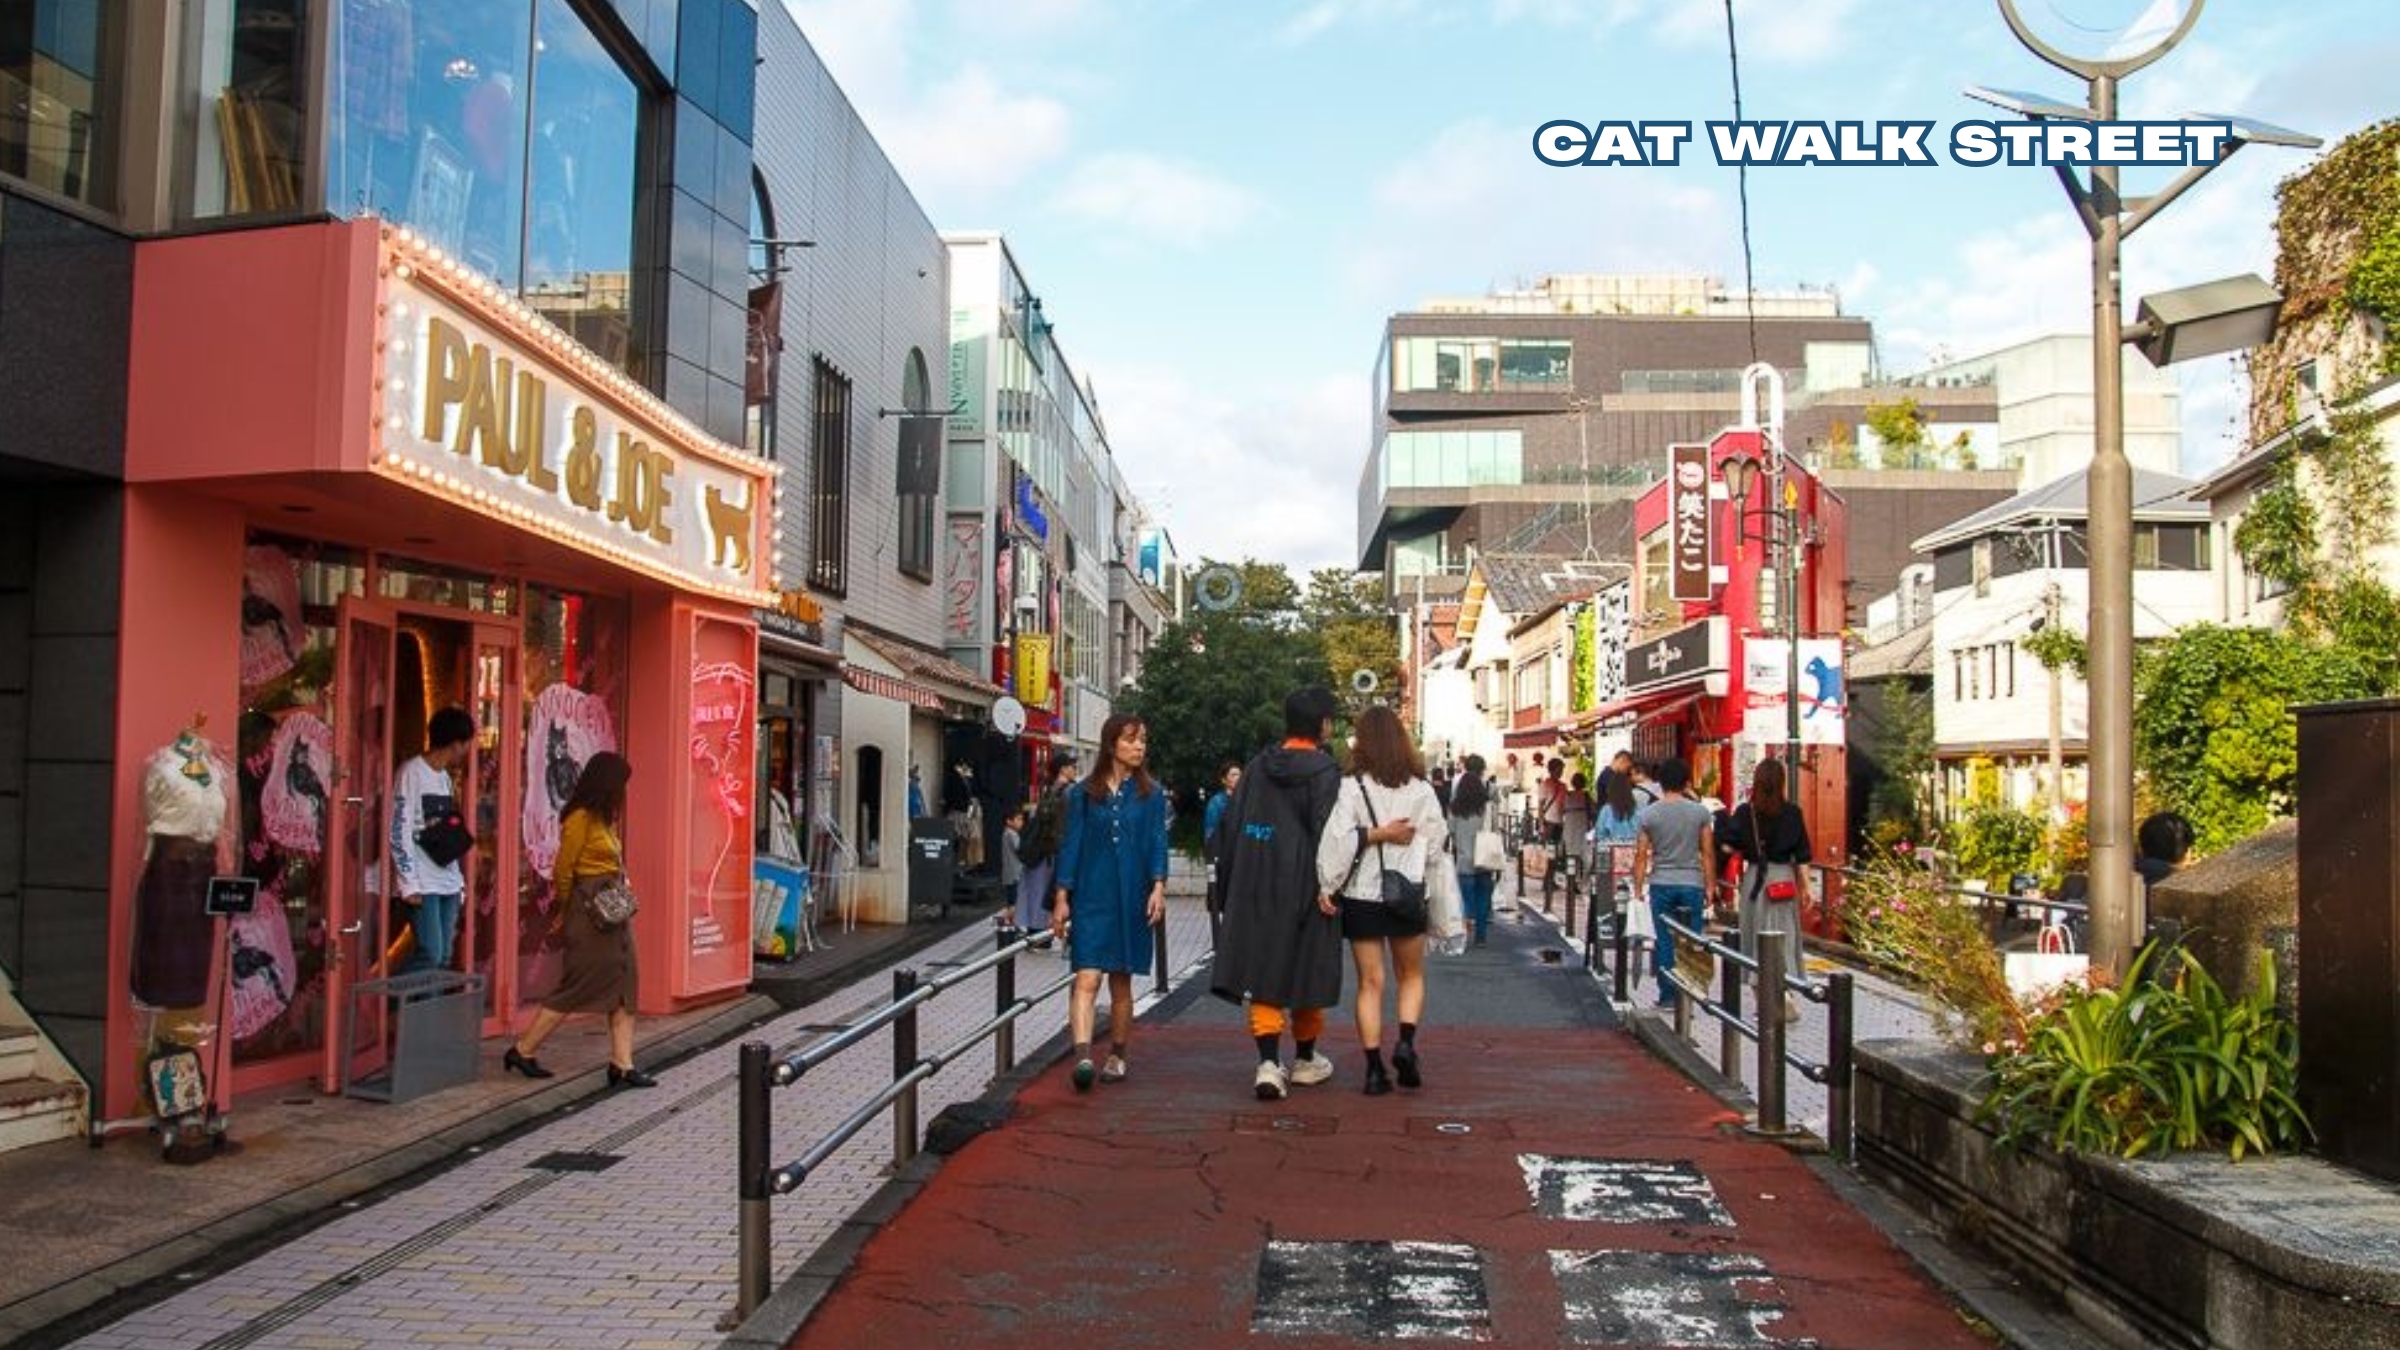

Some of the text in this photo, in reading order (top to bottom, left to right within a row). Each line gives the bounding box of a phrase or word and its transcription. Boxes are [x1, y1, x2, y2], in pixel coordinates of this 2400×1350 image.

[423, 317, 674, 545] PAUL & JOE
